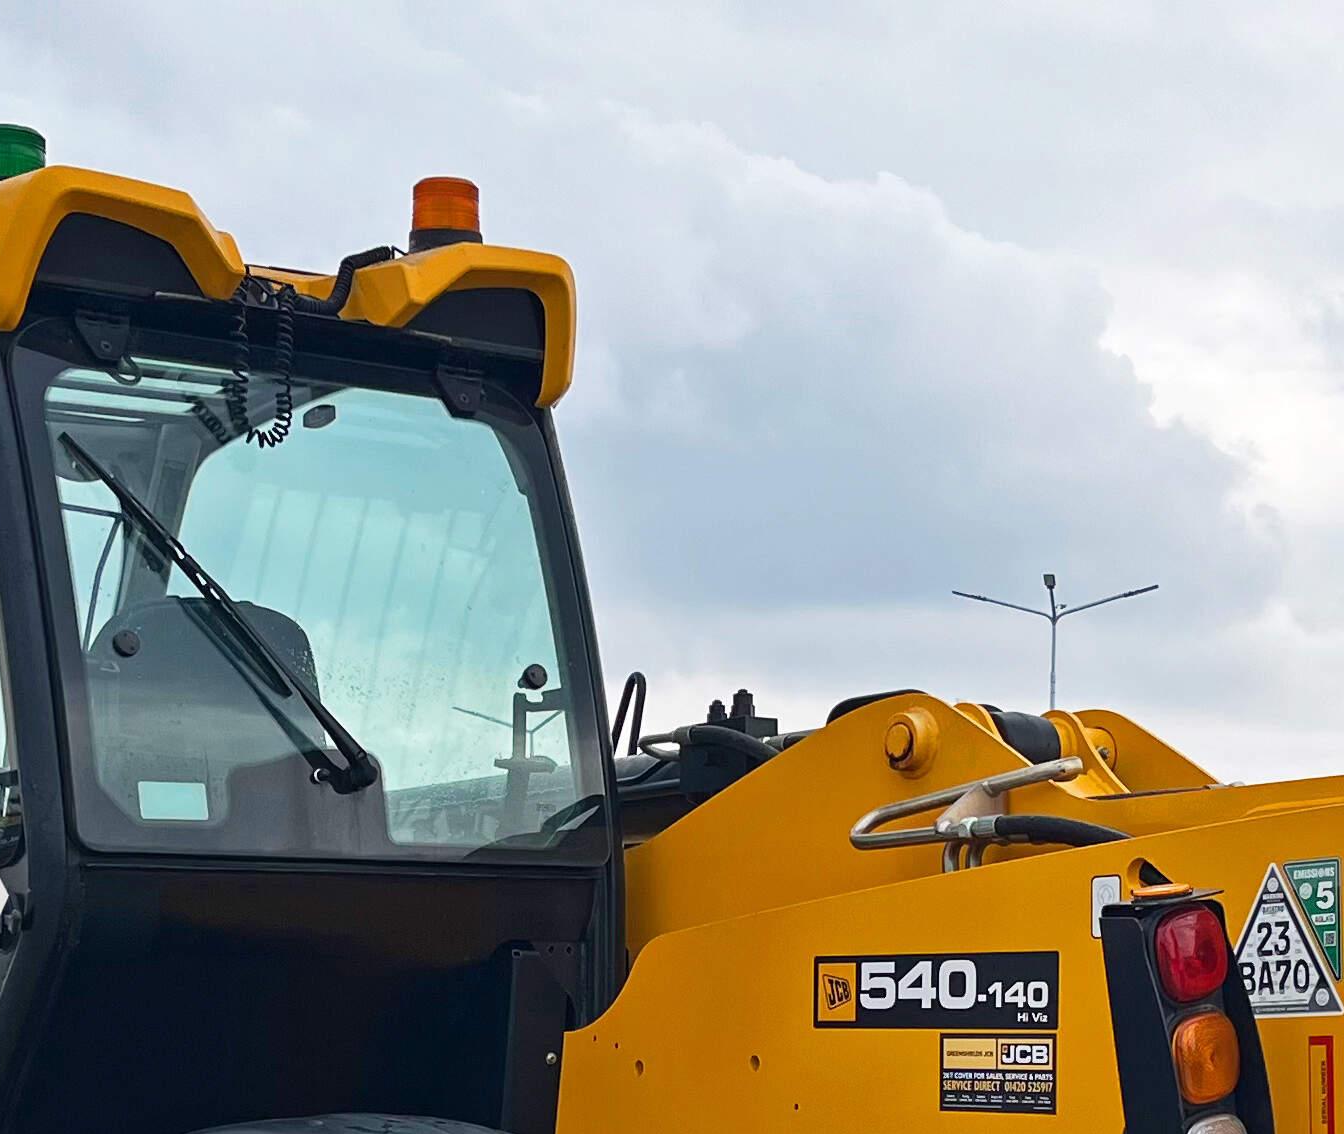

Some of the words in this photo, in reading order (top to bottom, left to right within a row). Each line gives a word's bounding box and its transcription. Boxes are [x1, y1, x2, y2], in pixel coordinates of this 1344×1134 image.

[1316, 881, 1334, 909] 5
[1257, 921, 1290, 957] 23
[827, 977, 851, 1006] JCB
[1239, 959, 1310, 996] BA70
[1017, 1012, 1029, 1023] Hi
[1032, 1012, 1049, 1023] Viz
[1001, 1045, 1049, 1064] JCB
[943, 1080, 972, 1091] SERVICE
[974, 1081, 1001, 1092] DIRECT
